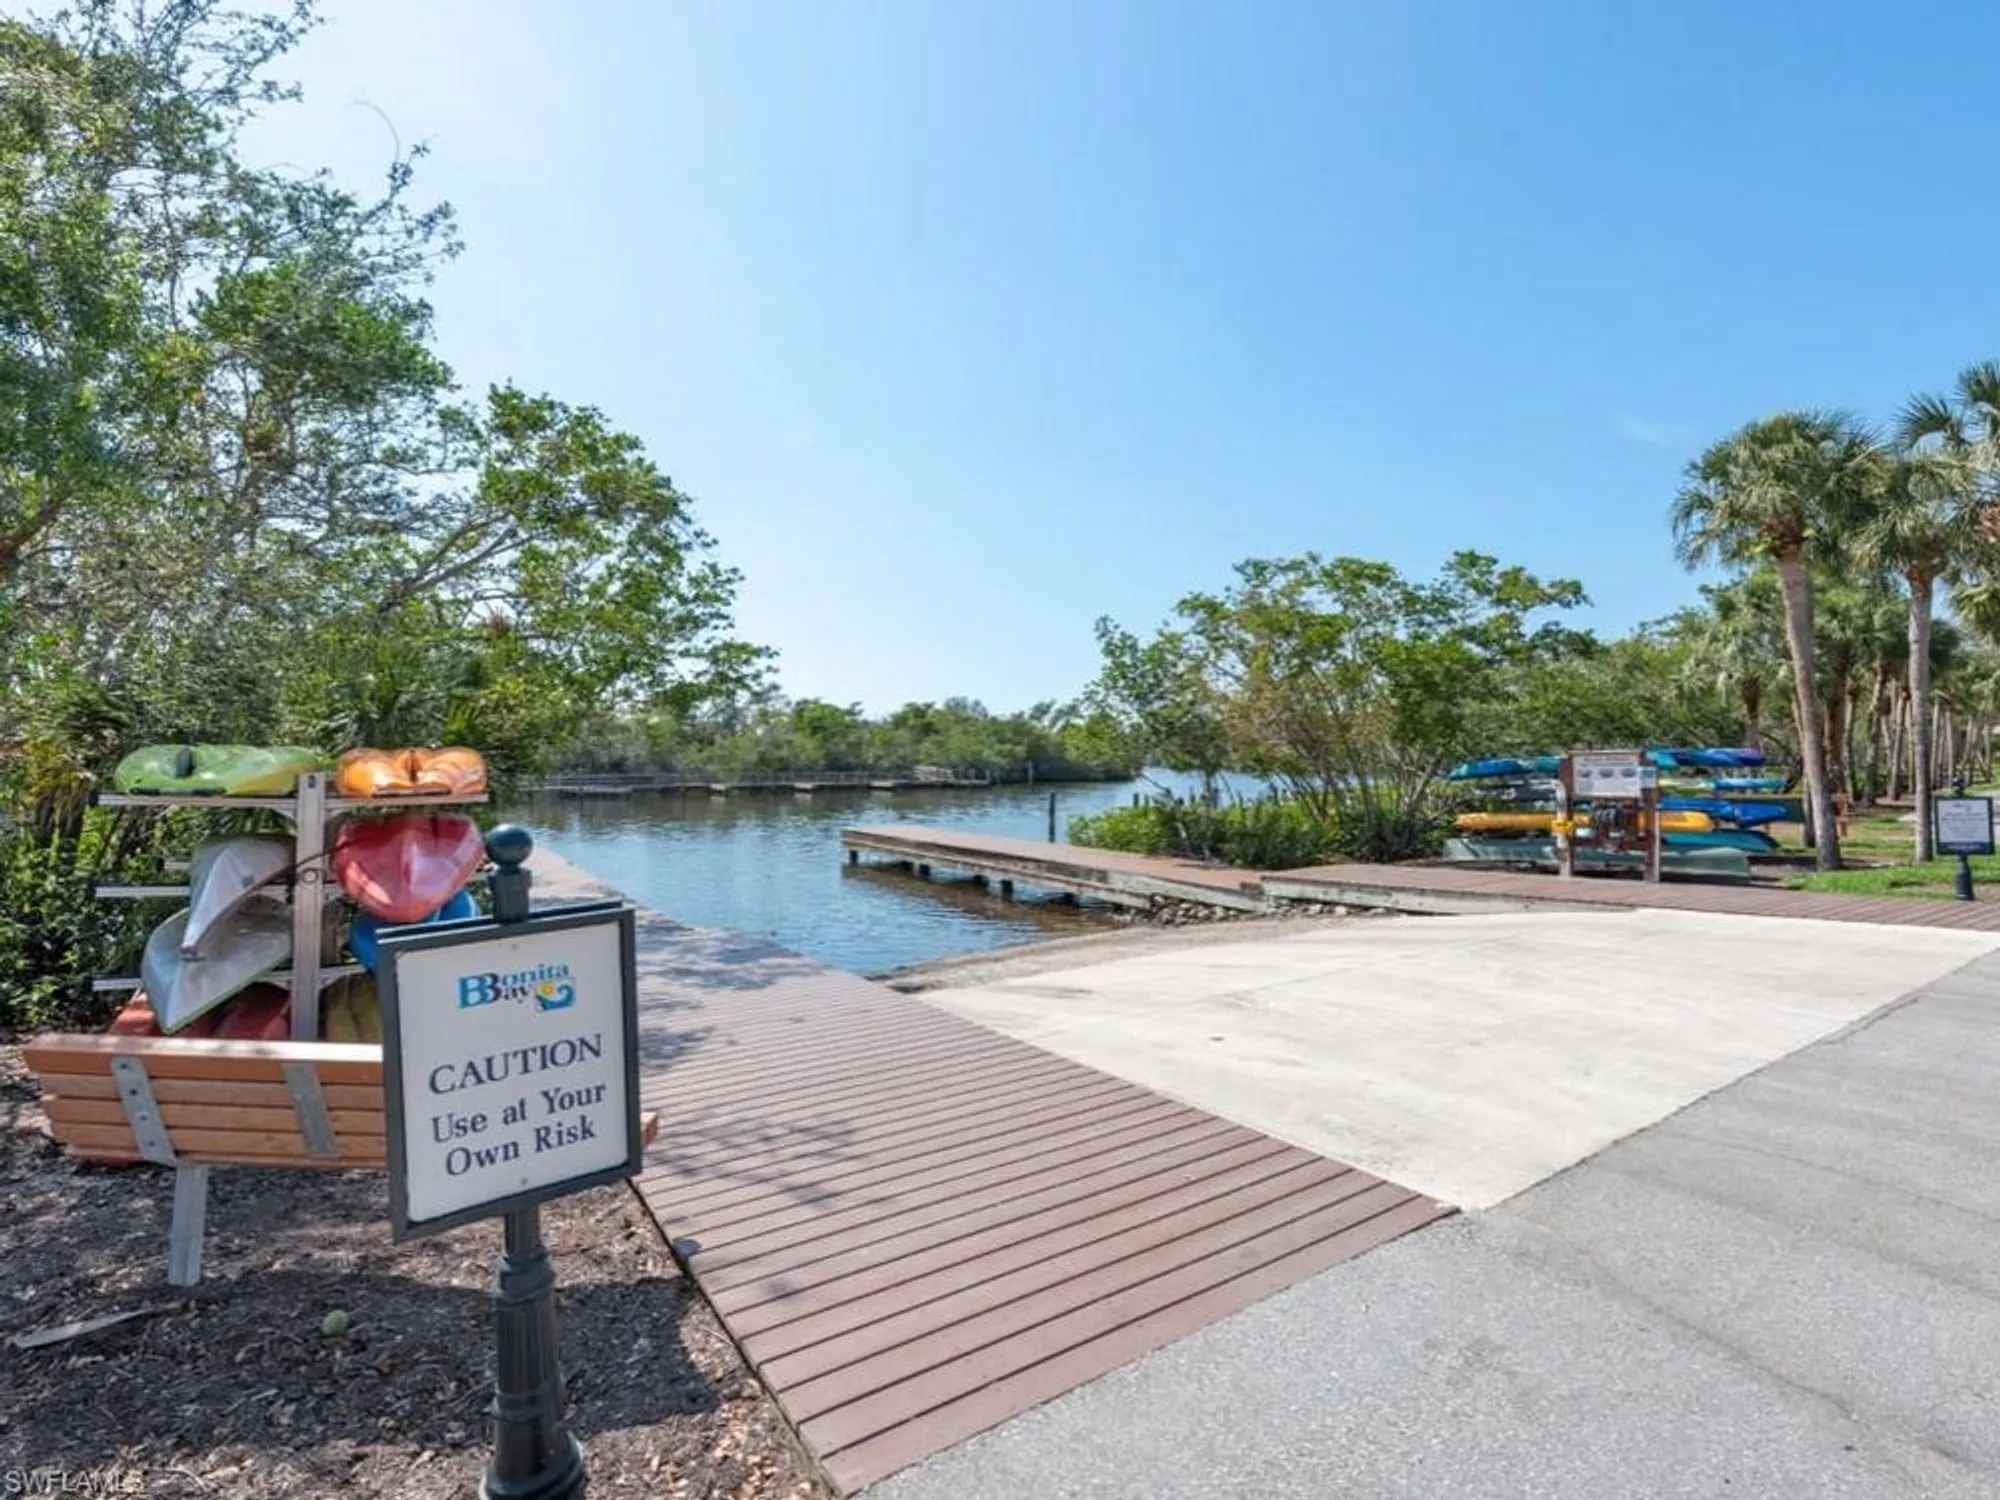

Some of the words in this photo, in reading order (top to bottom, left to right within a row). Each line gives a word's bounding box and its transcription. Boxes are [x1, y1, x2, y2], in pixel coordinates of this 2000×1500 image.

[429, 1033, 603, 1095] CAUTION
[432, 1111, 488, 1144] Use
[502, 1099, 527, 1127] at
[540, 1082, 607, 1116] Your
[445, 1140, 521, 1176] Own
[533, 1114, 597, 1153] Risk
